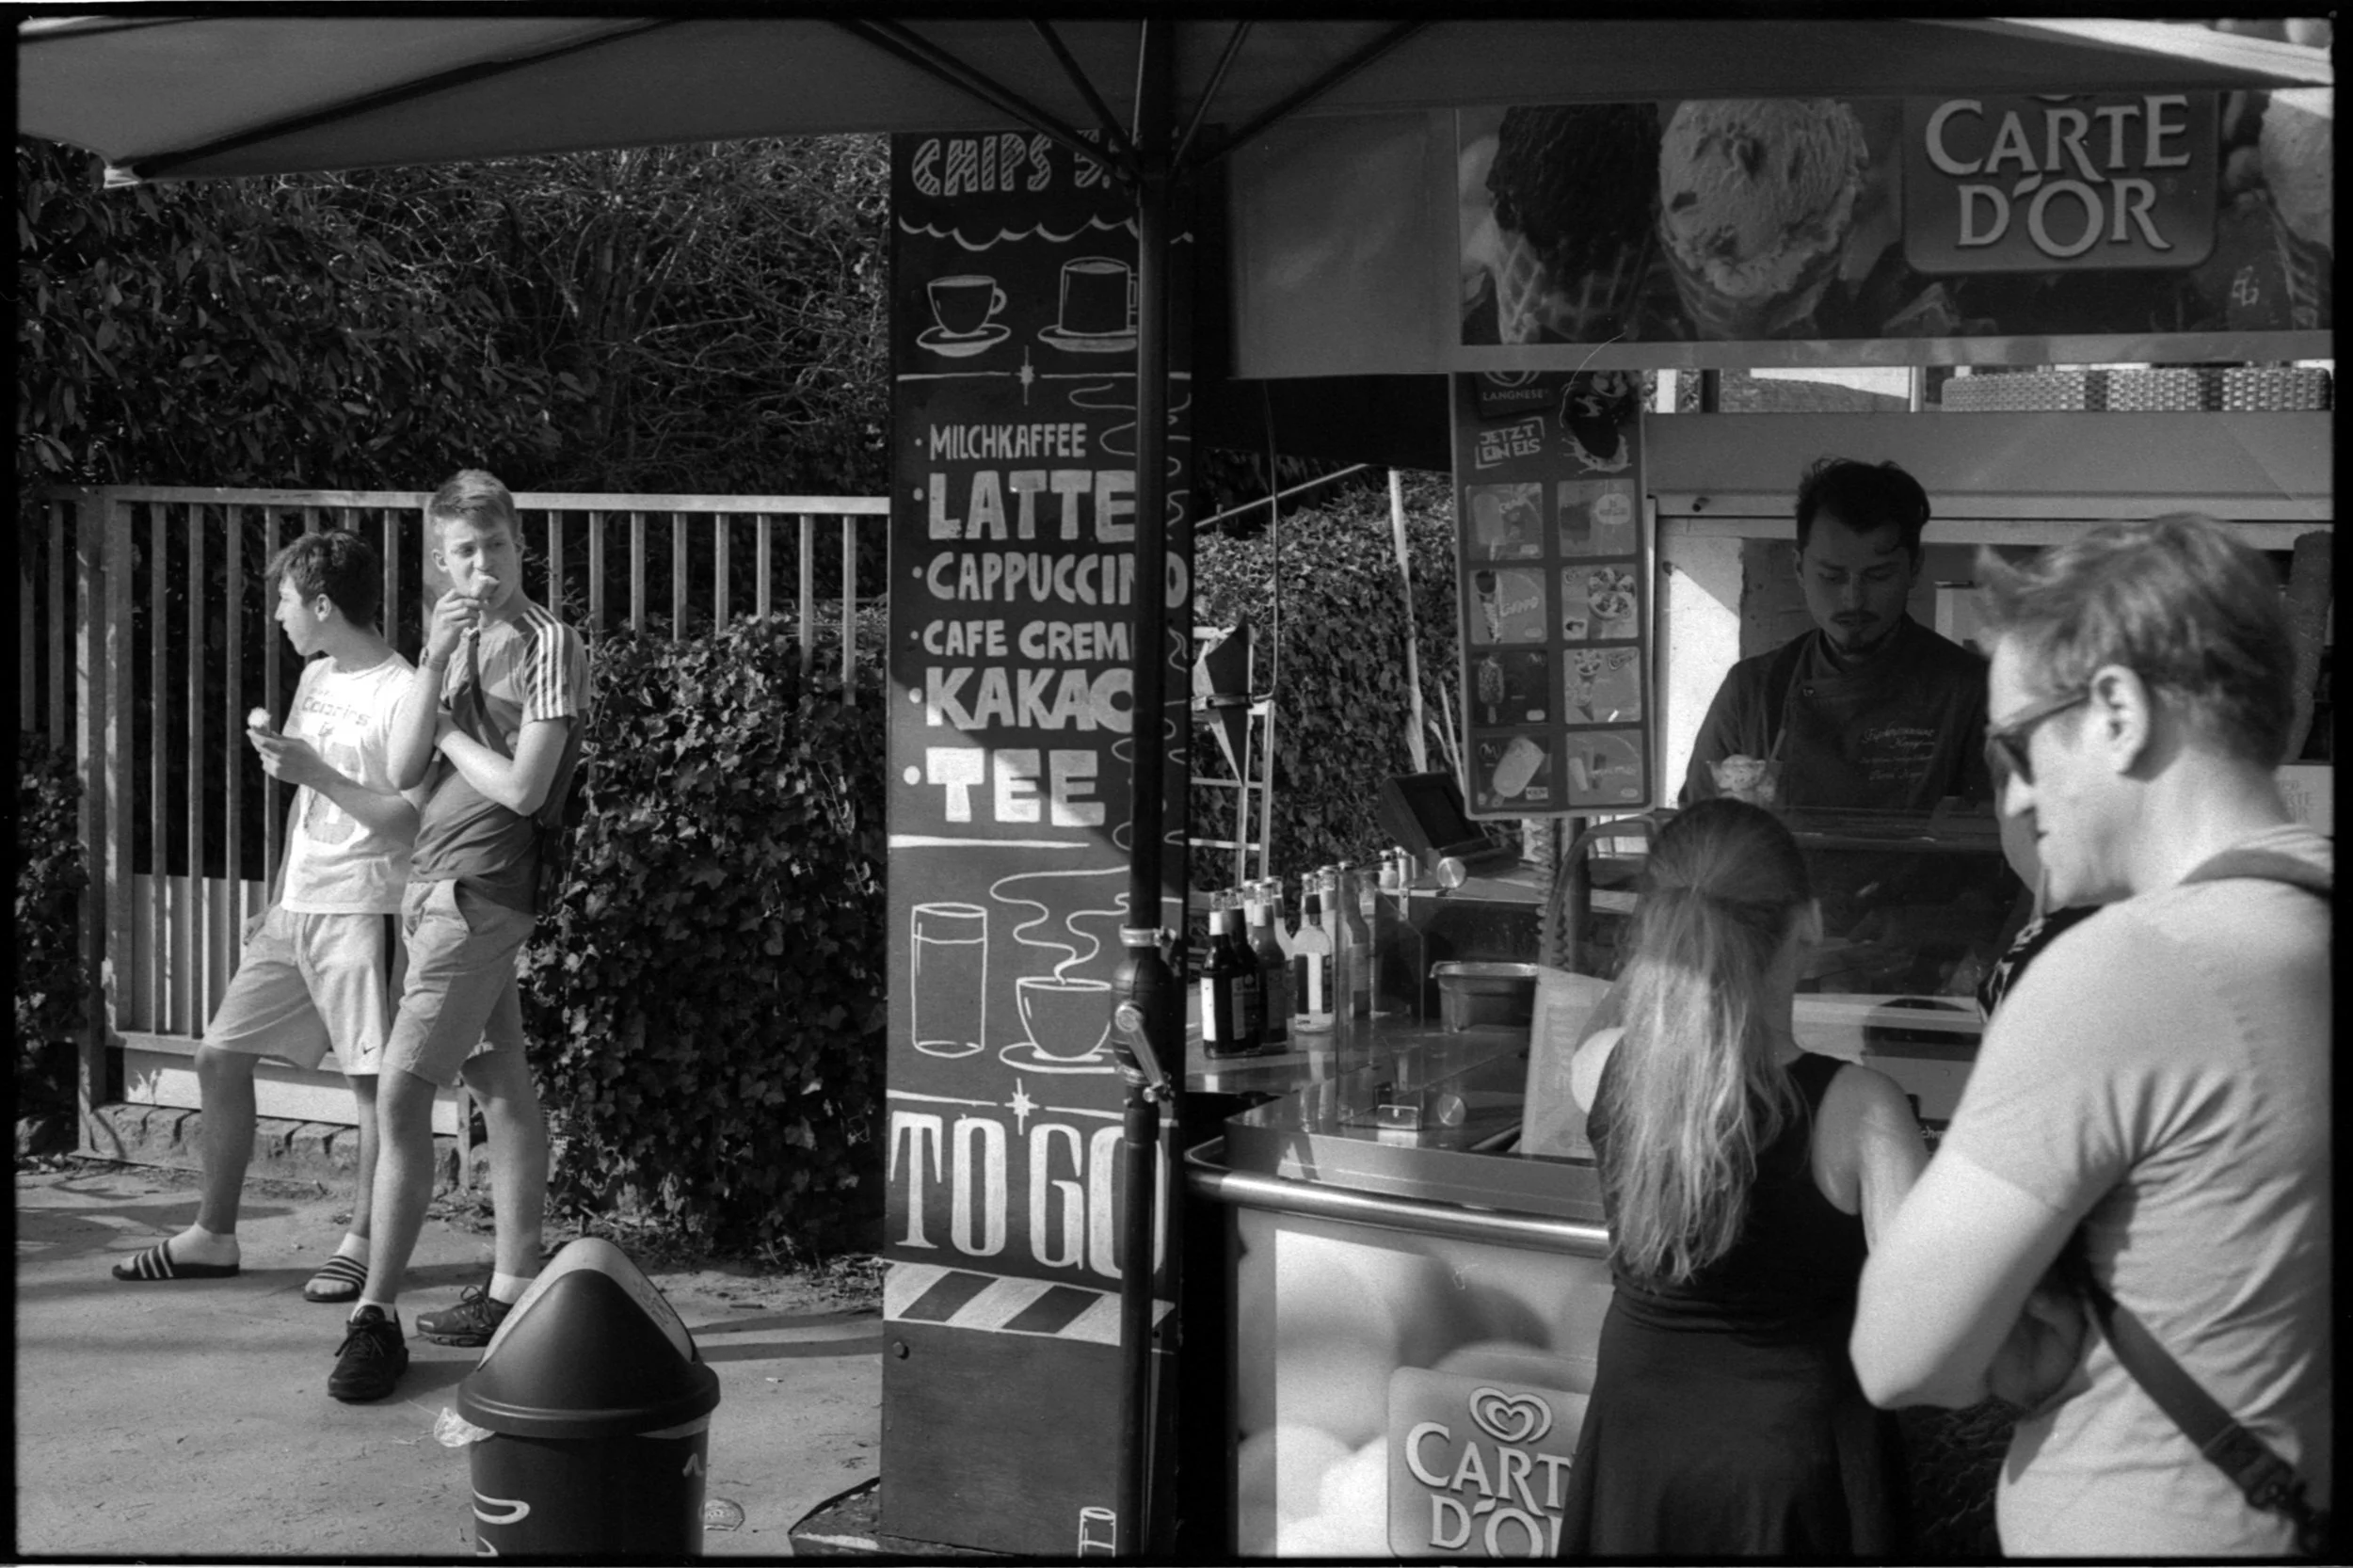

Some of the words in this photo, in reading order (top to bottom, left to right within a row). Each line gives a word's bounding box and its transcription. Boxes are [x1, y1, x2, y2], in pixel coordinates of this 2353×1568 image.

[911, 133, 1052, 196] CHIPS
[1925, 95, 2191, 183] CARTE
[1956, 172, 2171, 257] D'OR
[1482, 388, 1544, 402] LANGNESE
[929, 423, 1087, 461] MILCHKAFFEE
[1480, 424, 1534, 445] JETZT
[1513, 439, 1542, 457] EIS
[928, 469, 1136, 543] LATTE
[922, 619, 1008, 658] CAFE
[1017, 620, 1134, 661] CREM
[925, 746, 1106, 827] TEE
[889, 1110, 1007, 1256] TO
[1030, 1123, 1165, 1279] GO
[1405, 1421, 1572, 1517] CART
